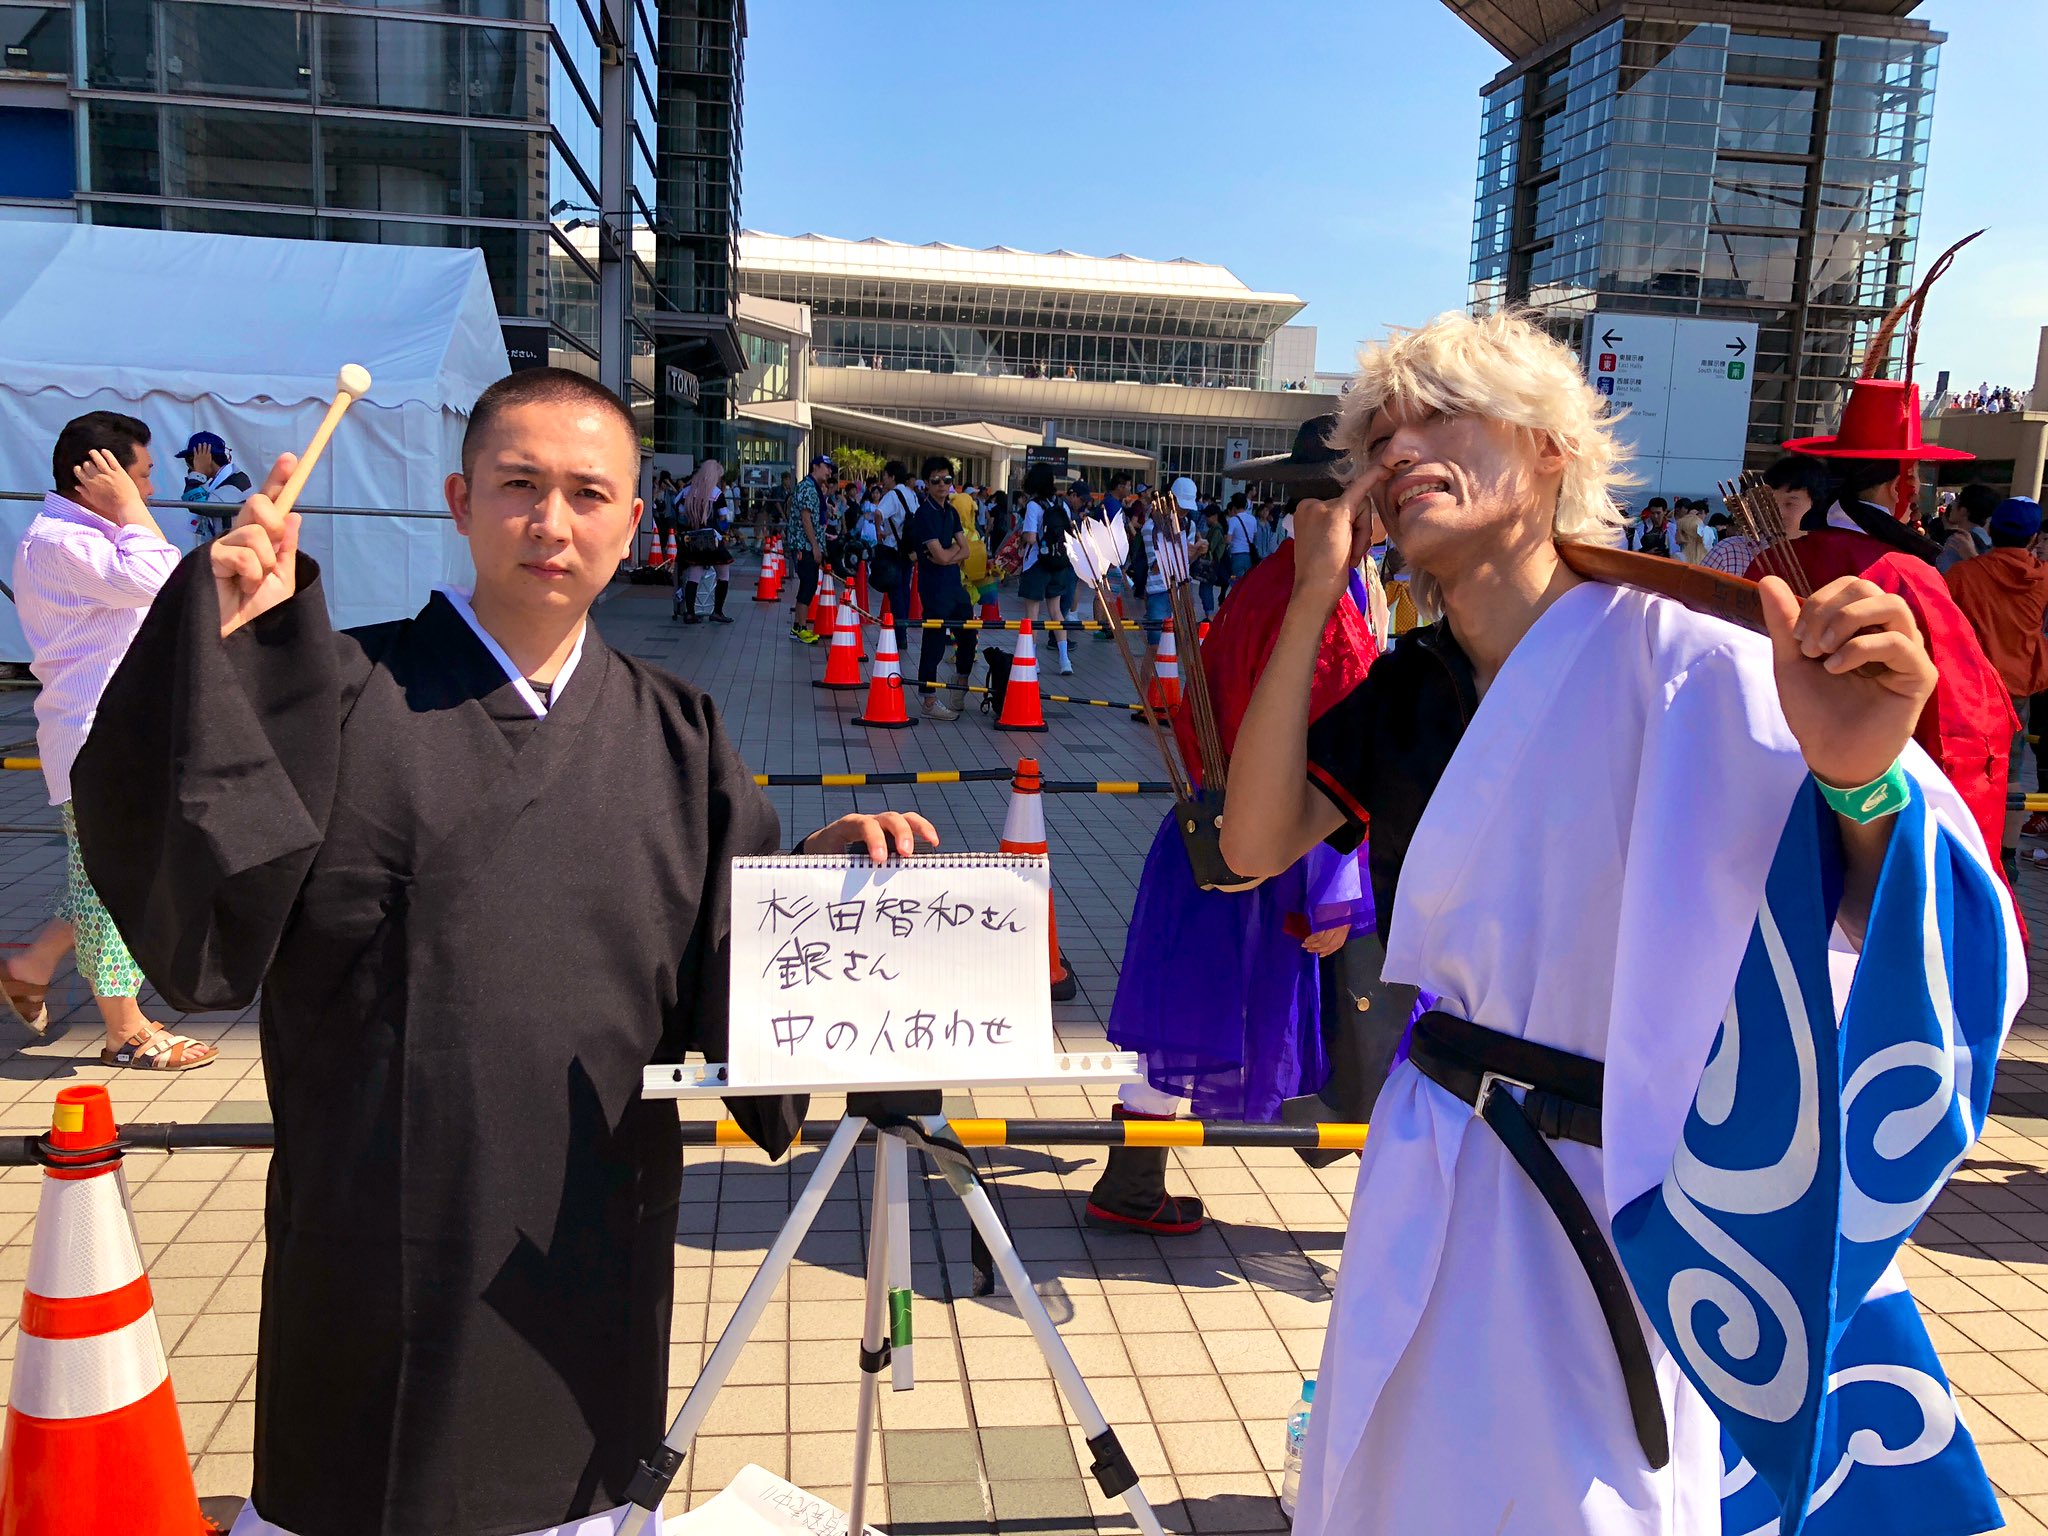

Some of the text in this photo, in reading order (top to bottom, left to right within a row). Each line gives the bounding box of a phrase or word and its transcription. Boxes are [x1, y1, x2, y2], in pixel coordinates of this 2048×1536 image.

[757, 888, 1028, 939] 杉田智和さん
[761, 936, 901, 990] 銀さん
[770, 1009, 1013, 1056] 中の人あわせ
